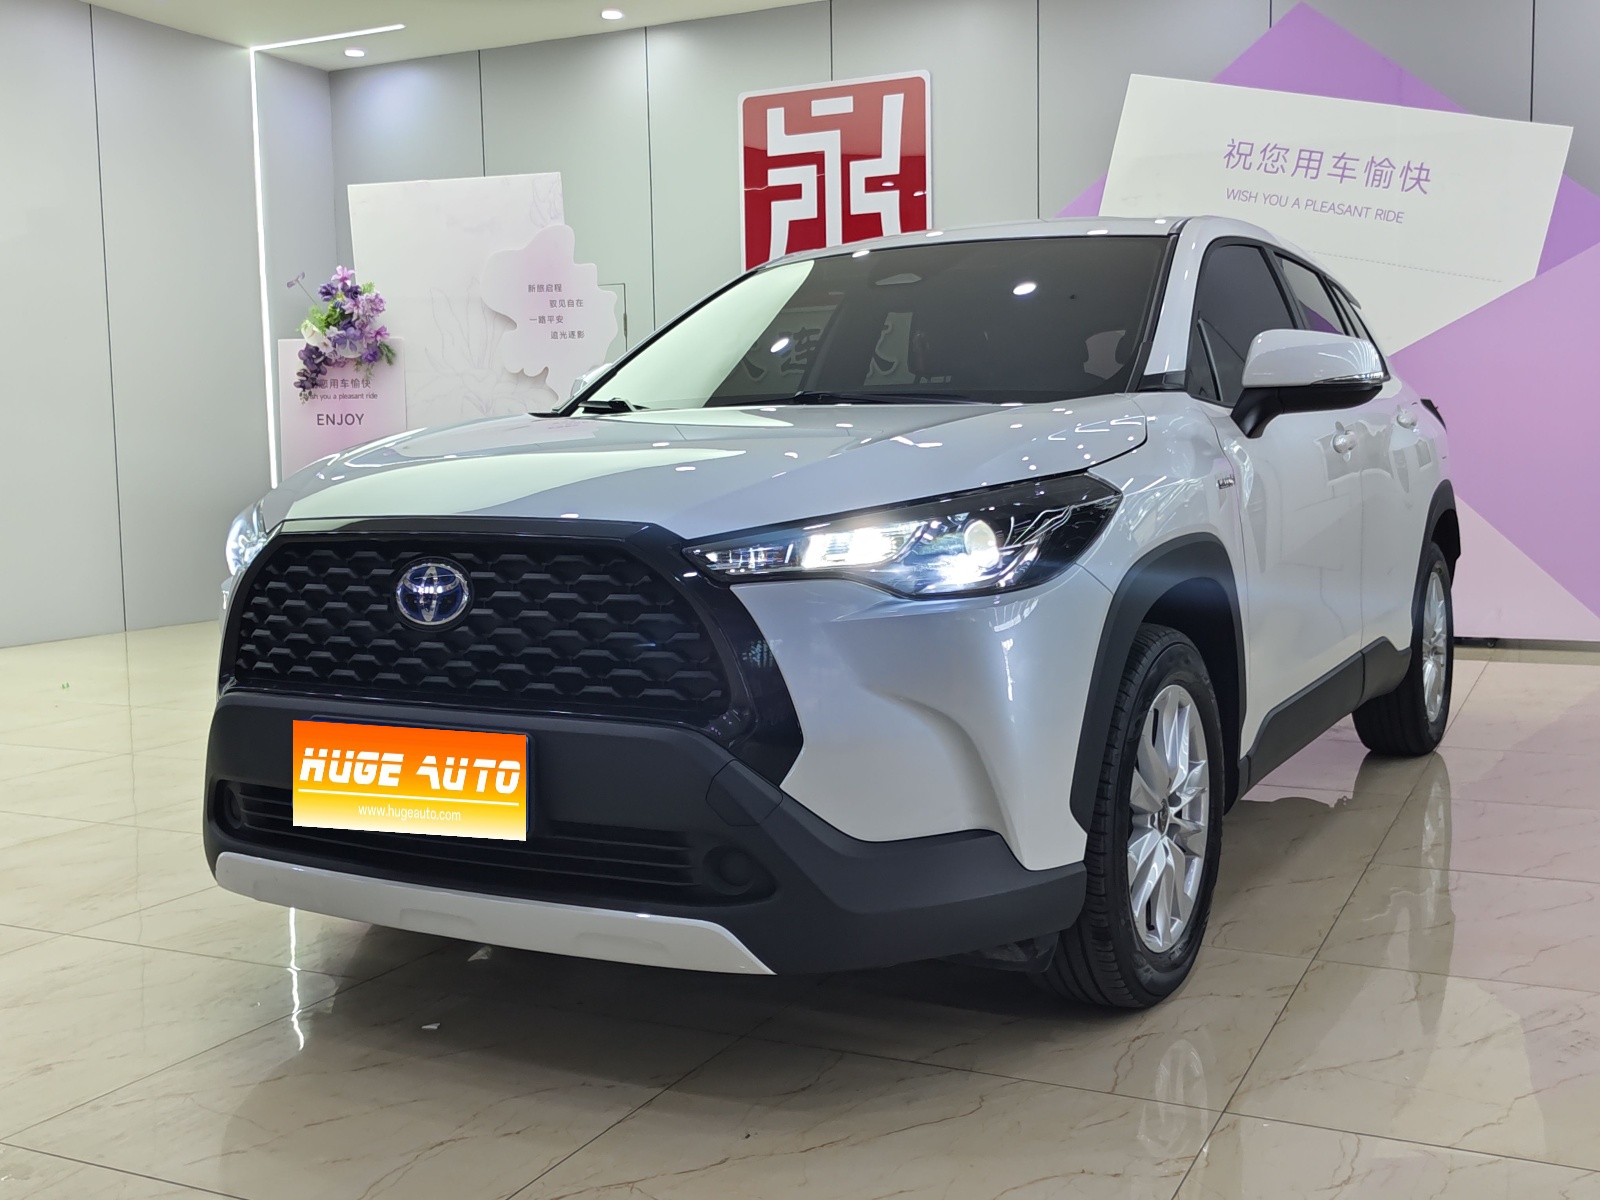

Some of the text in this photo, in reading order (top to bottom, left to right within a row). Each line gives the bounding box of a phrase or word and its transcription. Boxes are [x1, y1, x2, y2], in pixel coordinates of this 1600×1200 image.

[1223, 138, 1431, 195] 祝您用车愉快
[1226, 187, 1405, 224] WISH YOU A PLEASANT RIDE
[527, 284, 563, 293] 新旅启程
[549, 299, 584, 308] 驭见自在
[529, 315, 564, 324] 一路平安
[550, 330, 586, 340] 追光逐影
[311, 378, 372, 389] 您用车愉快
[338, 393, 365, 401] pleasant
[365, 392, 378, 400] ride
[316, 413, 365, 426] ENJOY
